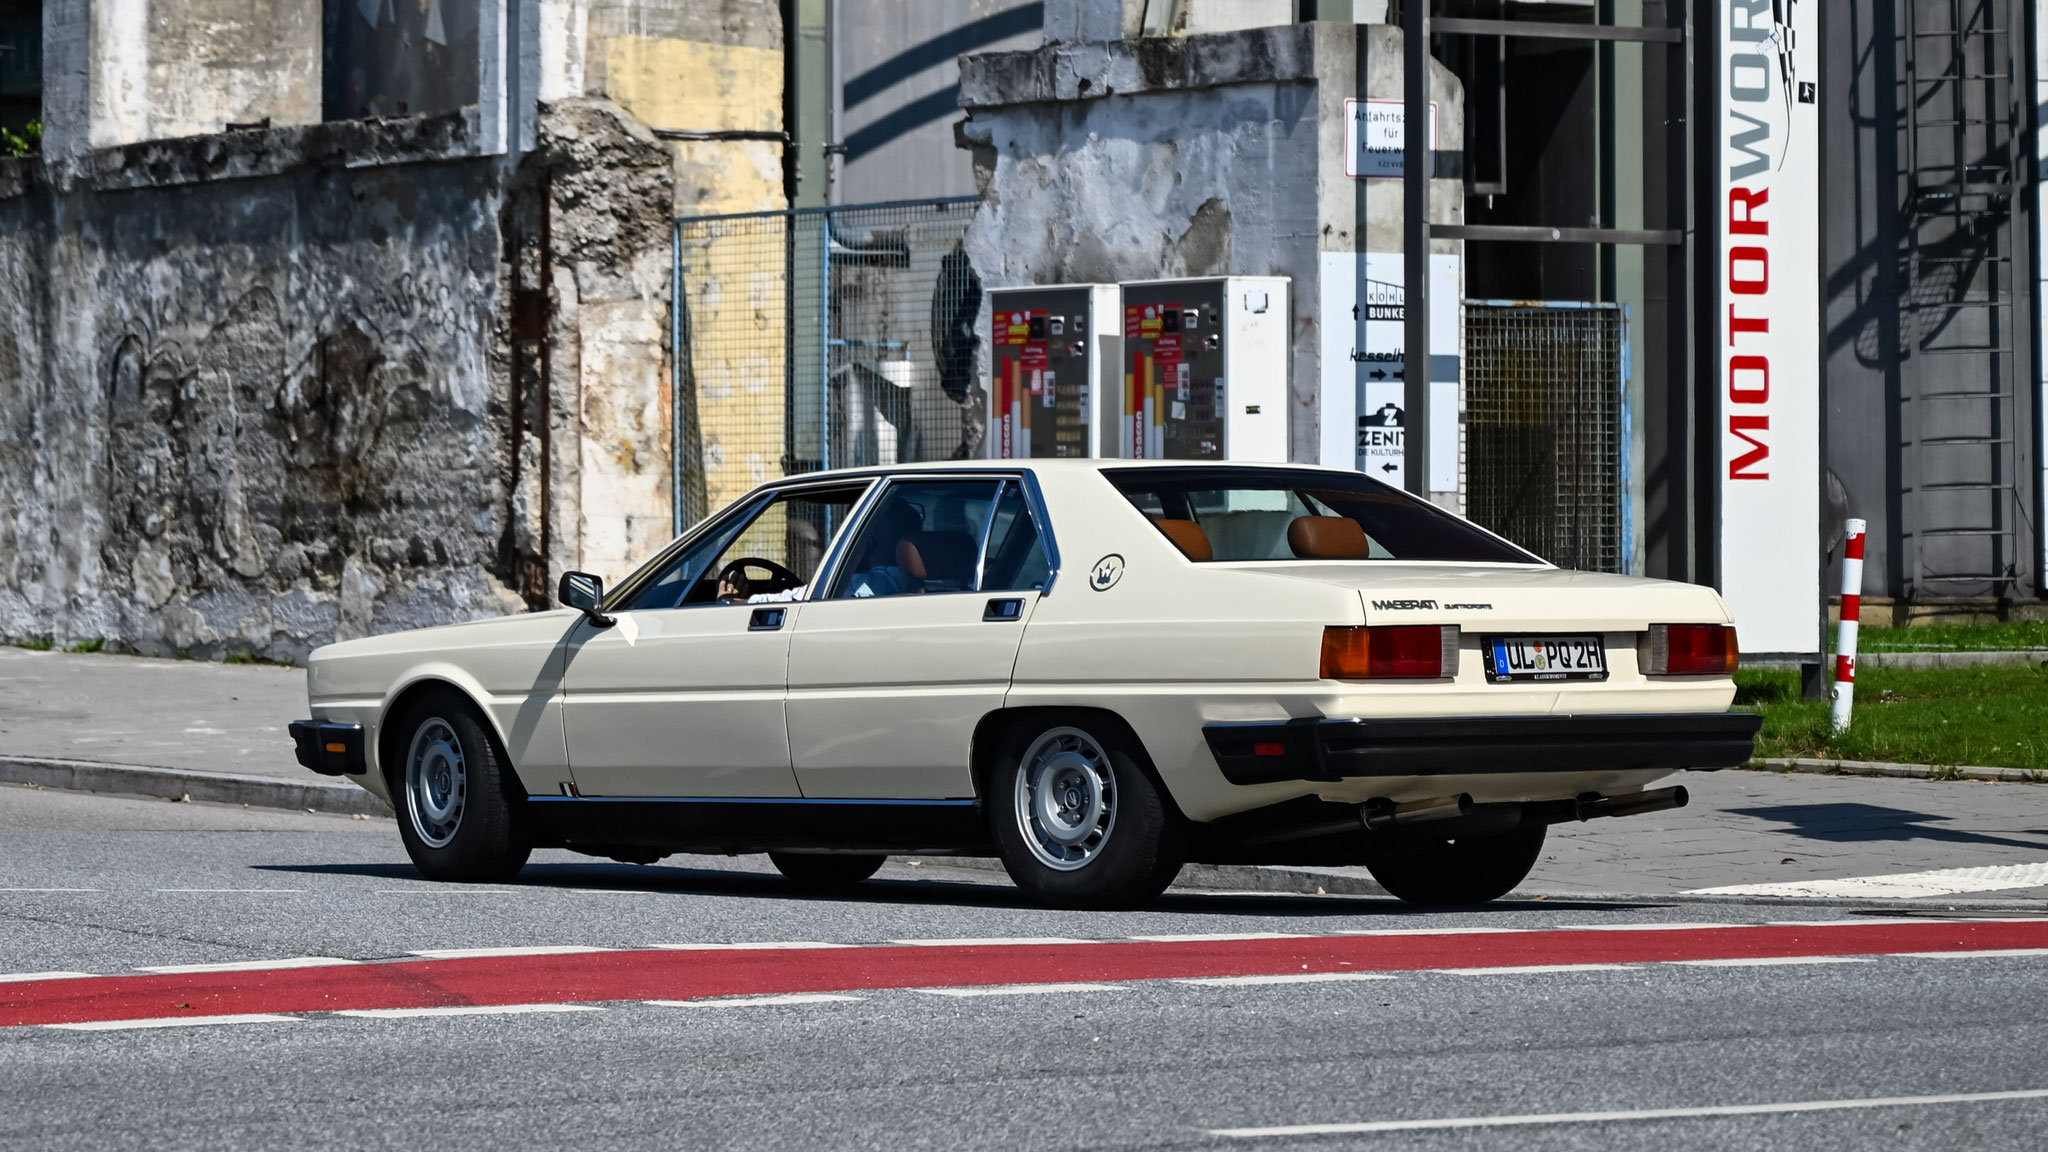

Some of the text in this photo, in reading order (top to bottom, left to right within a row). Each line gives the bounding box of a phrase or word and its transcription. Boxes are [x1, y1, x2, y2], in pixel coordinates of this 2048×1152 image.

[1354, 110, 1404, 122] Anfahrts
[1384, 127, 1399, 138] für
[1729, 0, 1770, 481] MOTORWOR
[1369, 293, 1404, 302] KOHL
[1369, 307, 1404, 319] BUNKE
[1350, 347, 1404, 362] kesselh
[1384, 408, 1397, 426] Z
[1507, 641, 1601, 669] UL PQ 2H
[1500, 659, 1505, 668] D
